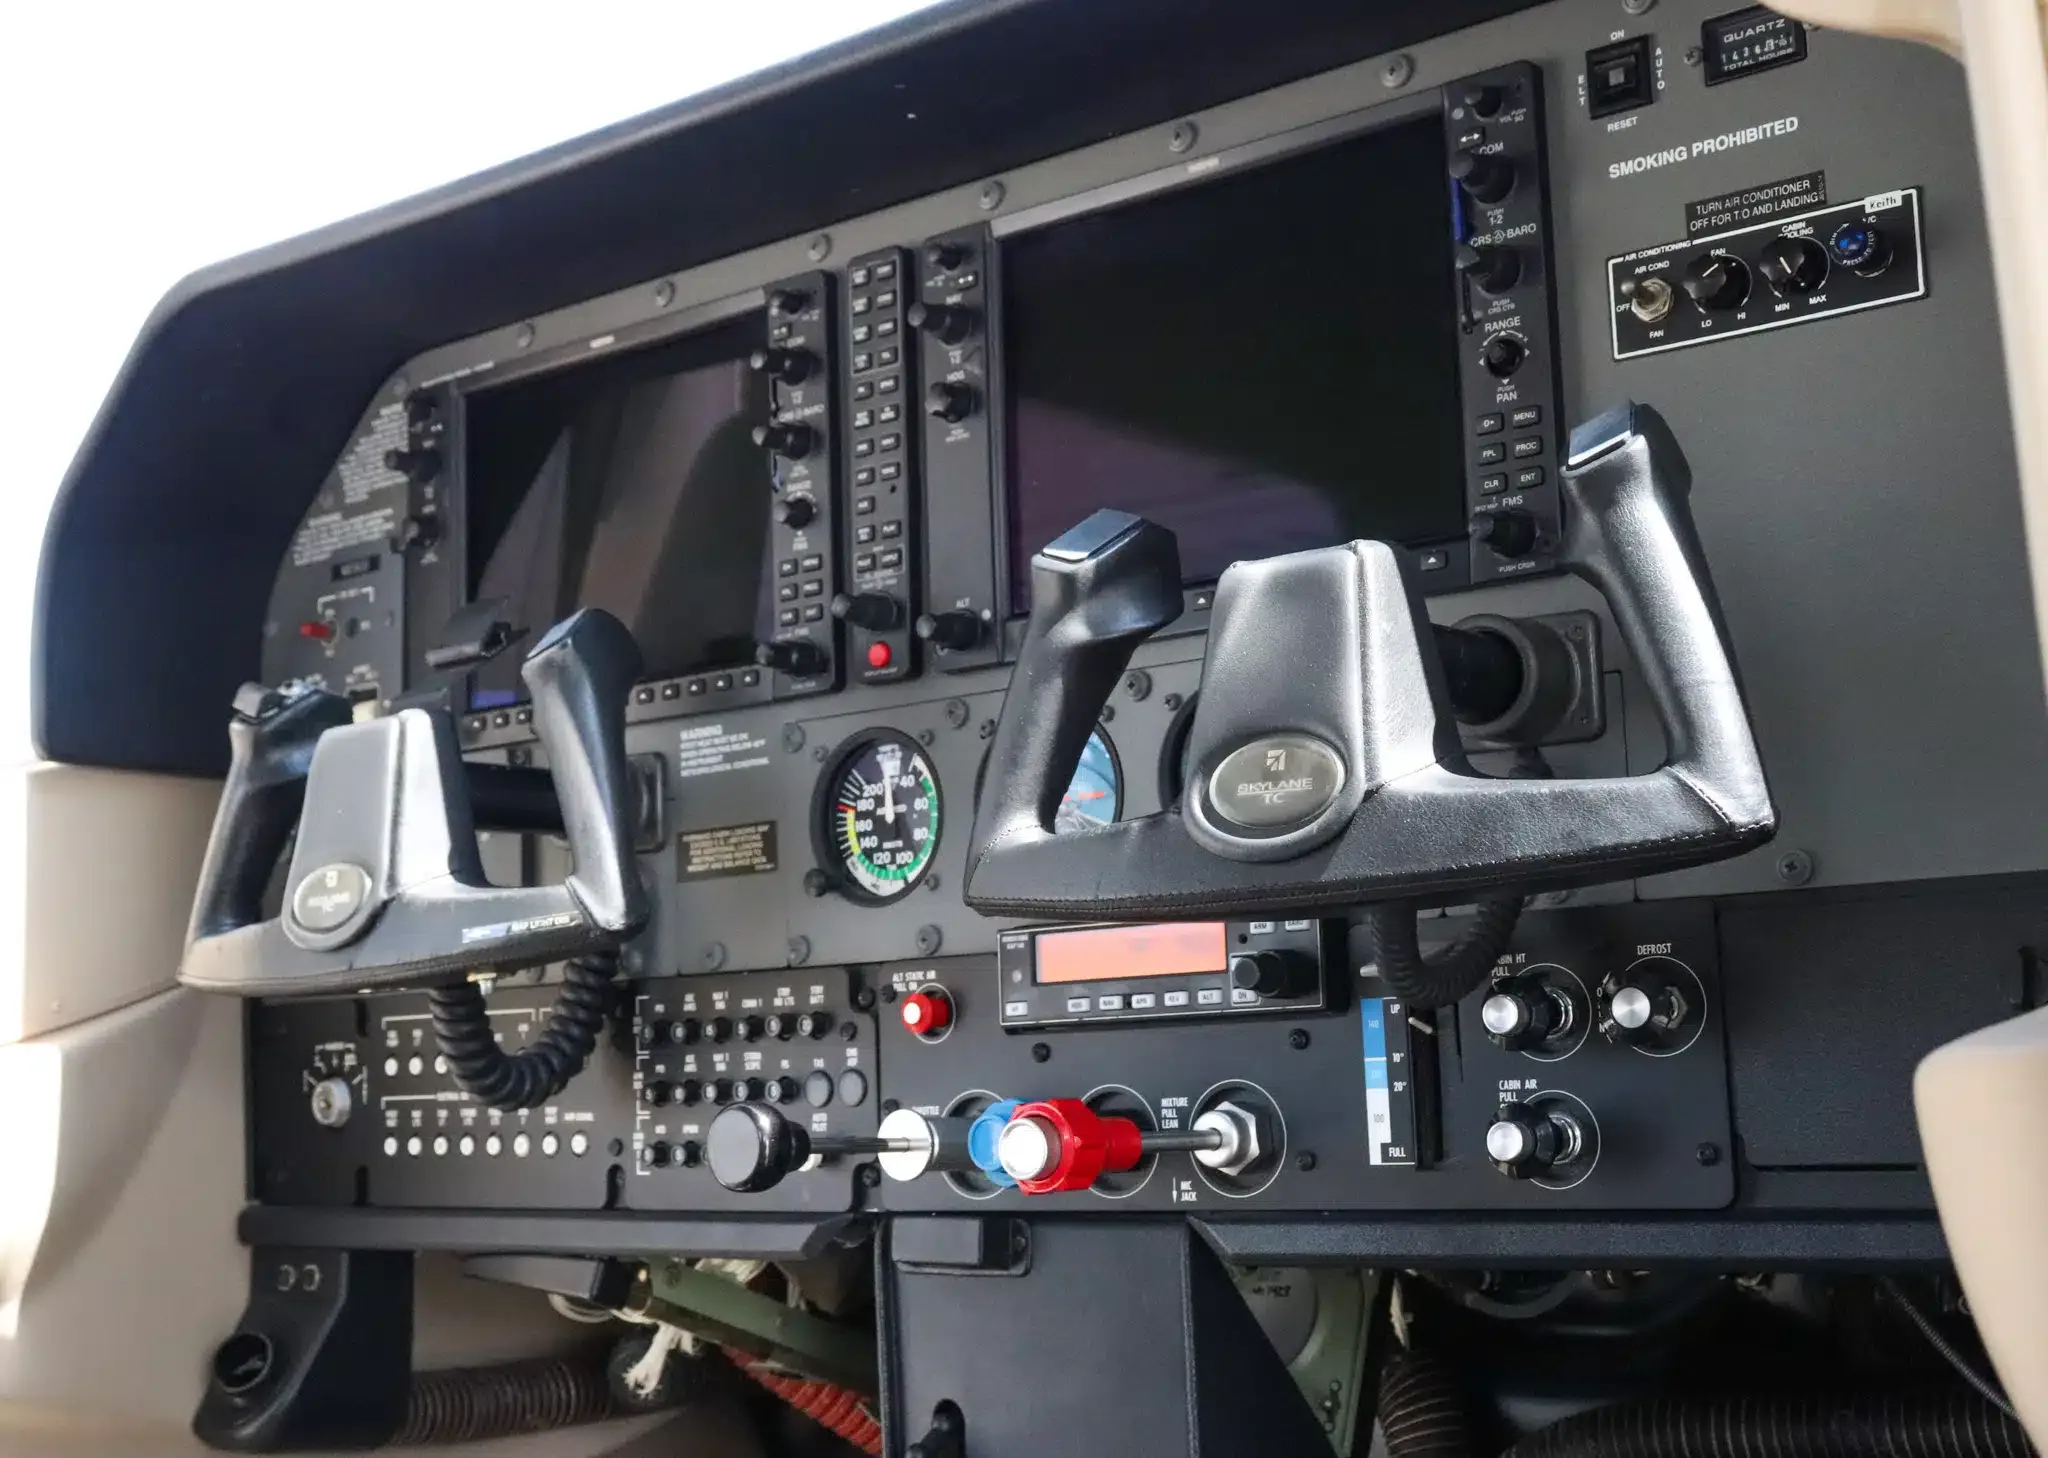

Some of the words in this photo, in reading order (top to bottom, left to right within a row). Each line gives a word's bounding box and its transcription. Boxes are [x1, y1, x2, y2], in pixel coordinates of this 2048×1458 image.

[1611, 29, 1625, 40] ON
[1723, 18, 1786, 43] QUARTZ
[1655, 47, 1666, 91] AUTO
[1724, 59, 1756, 71] TOTAL
[1578, 74, 1586, 106] ELT
[1607, 116, 1638, 133] RESET
[1608, 146, 1688, 179] SMOKING
[1691, 116, 1799, 157] PROHIBITED
[1696, 200, 1723, 215] TURN
[1724, 196, 1741, 209] AIR
[1742, 179, 1811, 205] CONDITIONER
[1870, 196, 1897, 209] Keith
[1690, 217, 1709, 232] OFF
[1711, 212, 1732, 228] FOR
[1752, 202, 1774, 217] AND
[1774, 192, 1819, 212] LANDING
[1490, 215, 1503, 225] 1-2
[1782, 221, 1806, 233] CABIN
[1470, 234, 1492, 247] CRS
[1506, 223, 1537, 240] BARO
[1624, 253, 1637, 262] AIR
[1638, 240, 1691, 260] CONDITIONING
[1710, 248, 1726, 257] FAN
[1634, 265, 1647, 275] AIR
[1648, 261, 1670, 272] COND
[1809, 295, 1827, 304] MAX
[1616, 303, 1631, 313] OFF
[1775, 303, 1790, 312] MIN
[1737, 312, 1746, 320] HI
[1484, 316, 1521, 332] RANGE
[1701, 319, 1712, 328] LO
[1649, 329, 1664, 339] FAN
[1496, 391, 1518, 403] PAN
[1514, 410, 1536, 421] MENU
[1515, 441, 1537, 452] PROC
[1484, 479, 1499, 489] CLR
[1521, 473, 1536, 484] ENT
[1502, 496, 1523, 507] FMS
[900, 774, 915, 788] 40
[1237, 777, 1313, 794] SKYLANE
[862, 782, 884, 797] 200
[1263, 793, 1285, 805] TC
[913, 827, 929, 841] 80
[860, 835, 878, 849] 140
[872, 851, 892, 865] 120
[895, 851, 914, 864] 100
[1637, 943, 1672, 956] DEFROST
[1515, 953, 1526, 964] HT
[892, 972, 904, 982] ALT
[905, 971, 925, 982] STATIC
[926, 970, 936, 980] AIR
[1491, 966, 1511, 977] PULL
[1202, 993, 1213, 1001] ALT
[1390, 1004, 1400, 1014] UP
[1499, 1079, 1521, 1090] CABIN
[1525, 1078, 1537, 1089] AIR
[1161, 1097, 1189, 1107] MIXTURE
[1499, 1091, 1518, 1102] PULL
[1161, 1108, 1177, 1118] PULL
[1373, 1113, 1385, 1123] 100
[1162, 1119, 1179, 1129] LEAN
[1388, 1147, 1406, 1157] FULL
[1180, 1181, 1192, 1191] MIC
[1181, 1191, 1197, 1202] JACK
